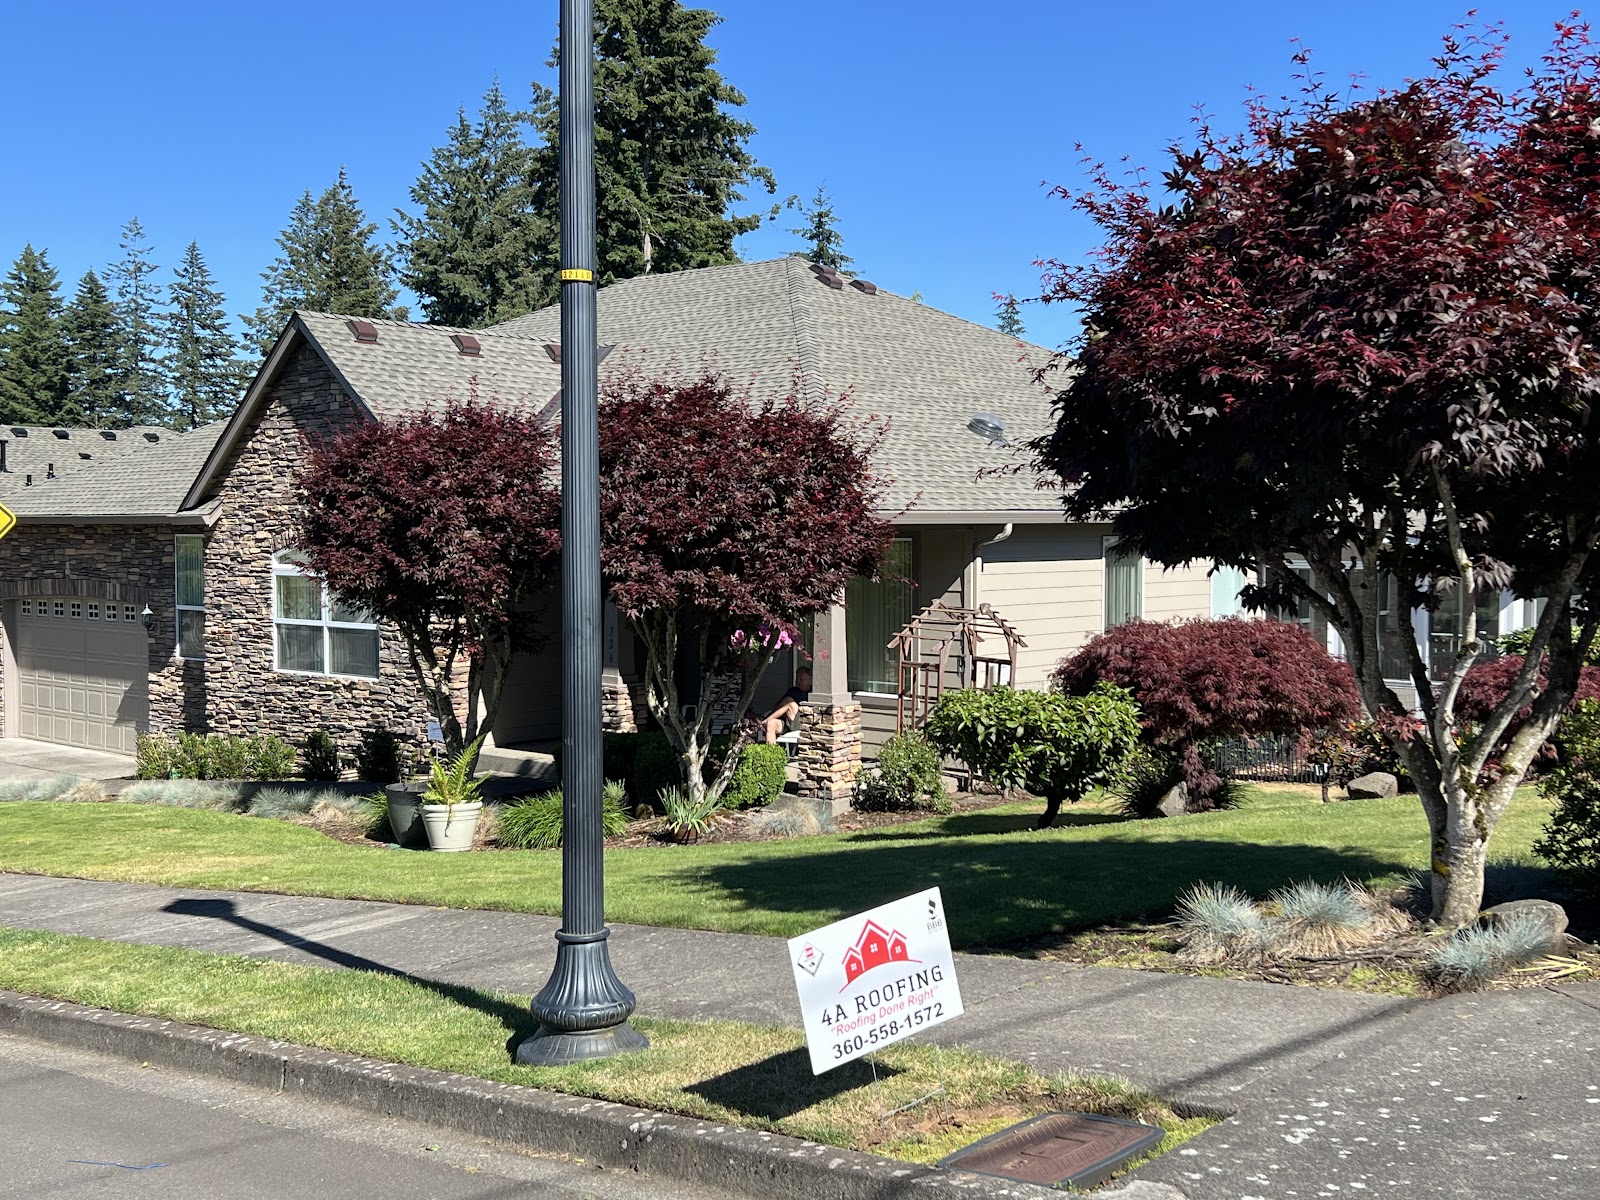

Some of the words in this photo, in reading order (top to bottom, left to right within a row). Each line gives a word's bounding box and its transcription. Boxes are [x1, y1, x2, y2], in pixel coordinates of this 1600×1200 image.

[563, 270, 591, 279] 32110
[926, 918, 943, 931] BBB
[821, 1004, 848, 1026] 4A
[855, 965, 944, 1014] ROOFING
[831, 1012, 876, 1037] "Roofing
[879, 1000, 905, 1018] Done
[832, 1002, 944, 1060] 360-558-1572
